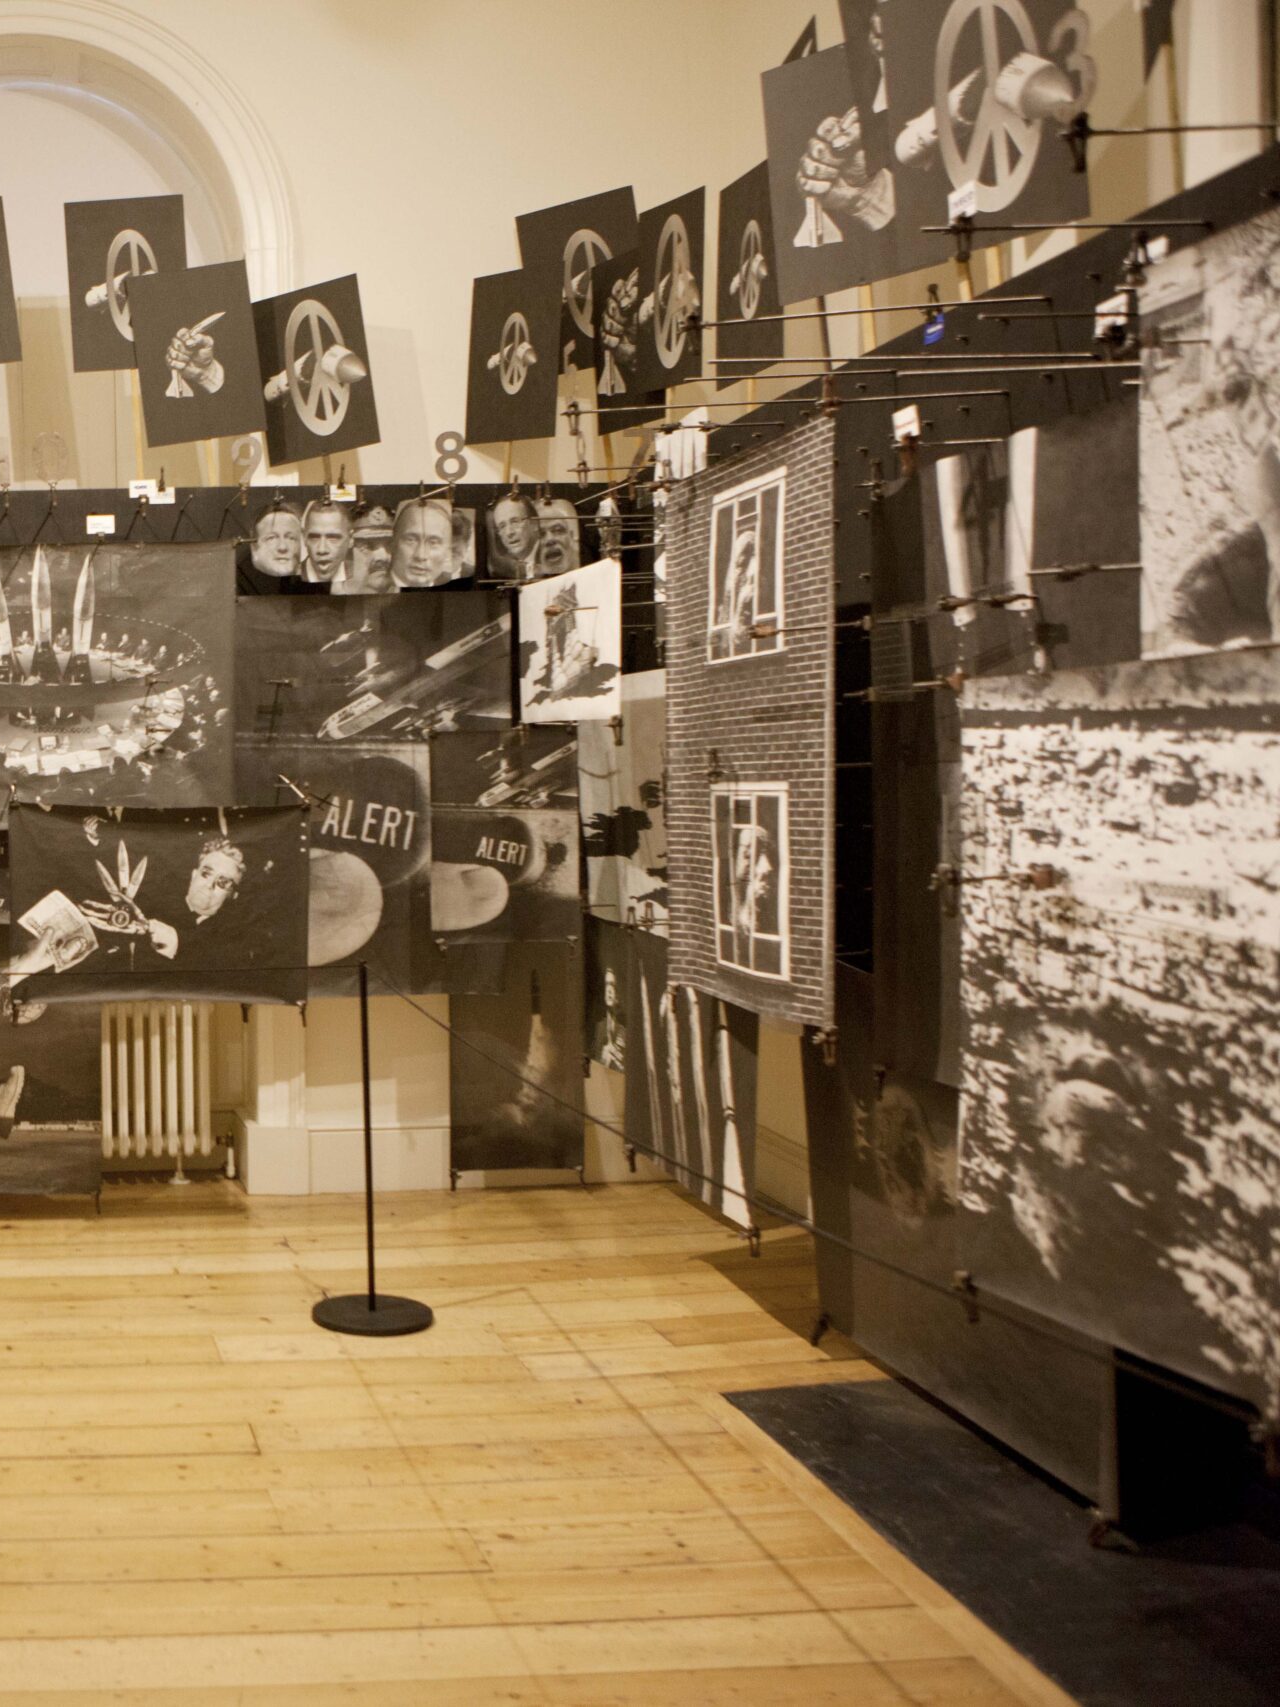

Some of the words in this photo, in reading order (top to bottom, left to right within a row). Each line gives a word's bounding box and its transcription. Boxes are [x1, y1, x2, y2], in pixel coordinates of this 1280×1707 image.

[231, 436, 262, 486] 9
[435, 431, 468, 482] 8
[320, 795, 418, 851] ALERT
[475, 836, 528, 866] ALERT
